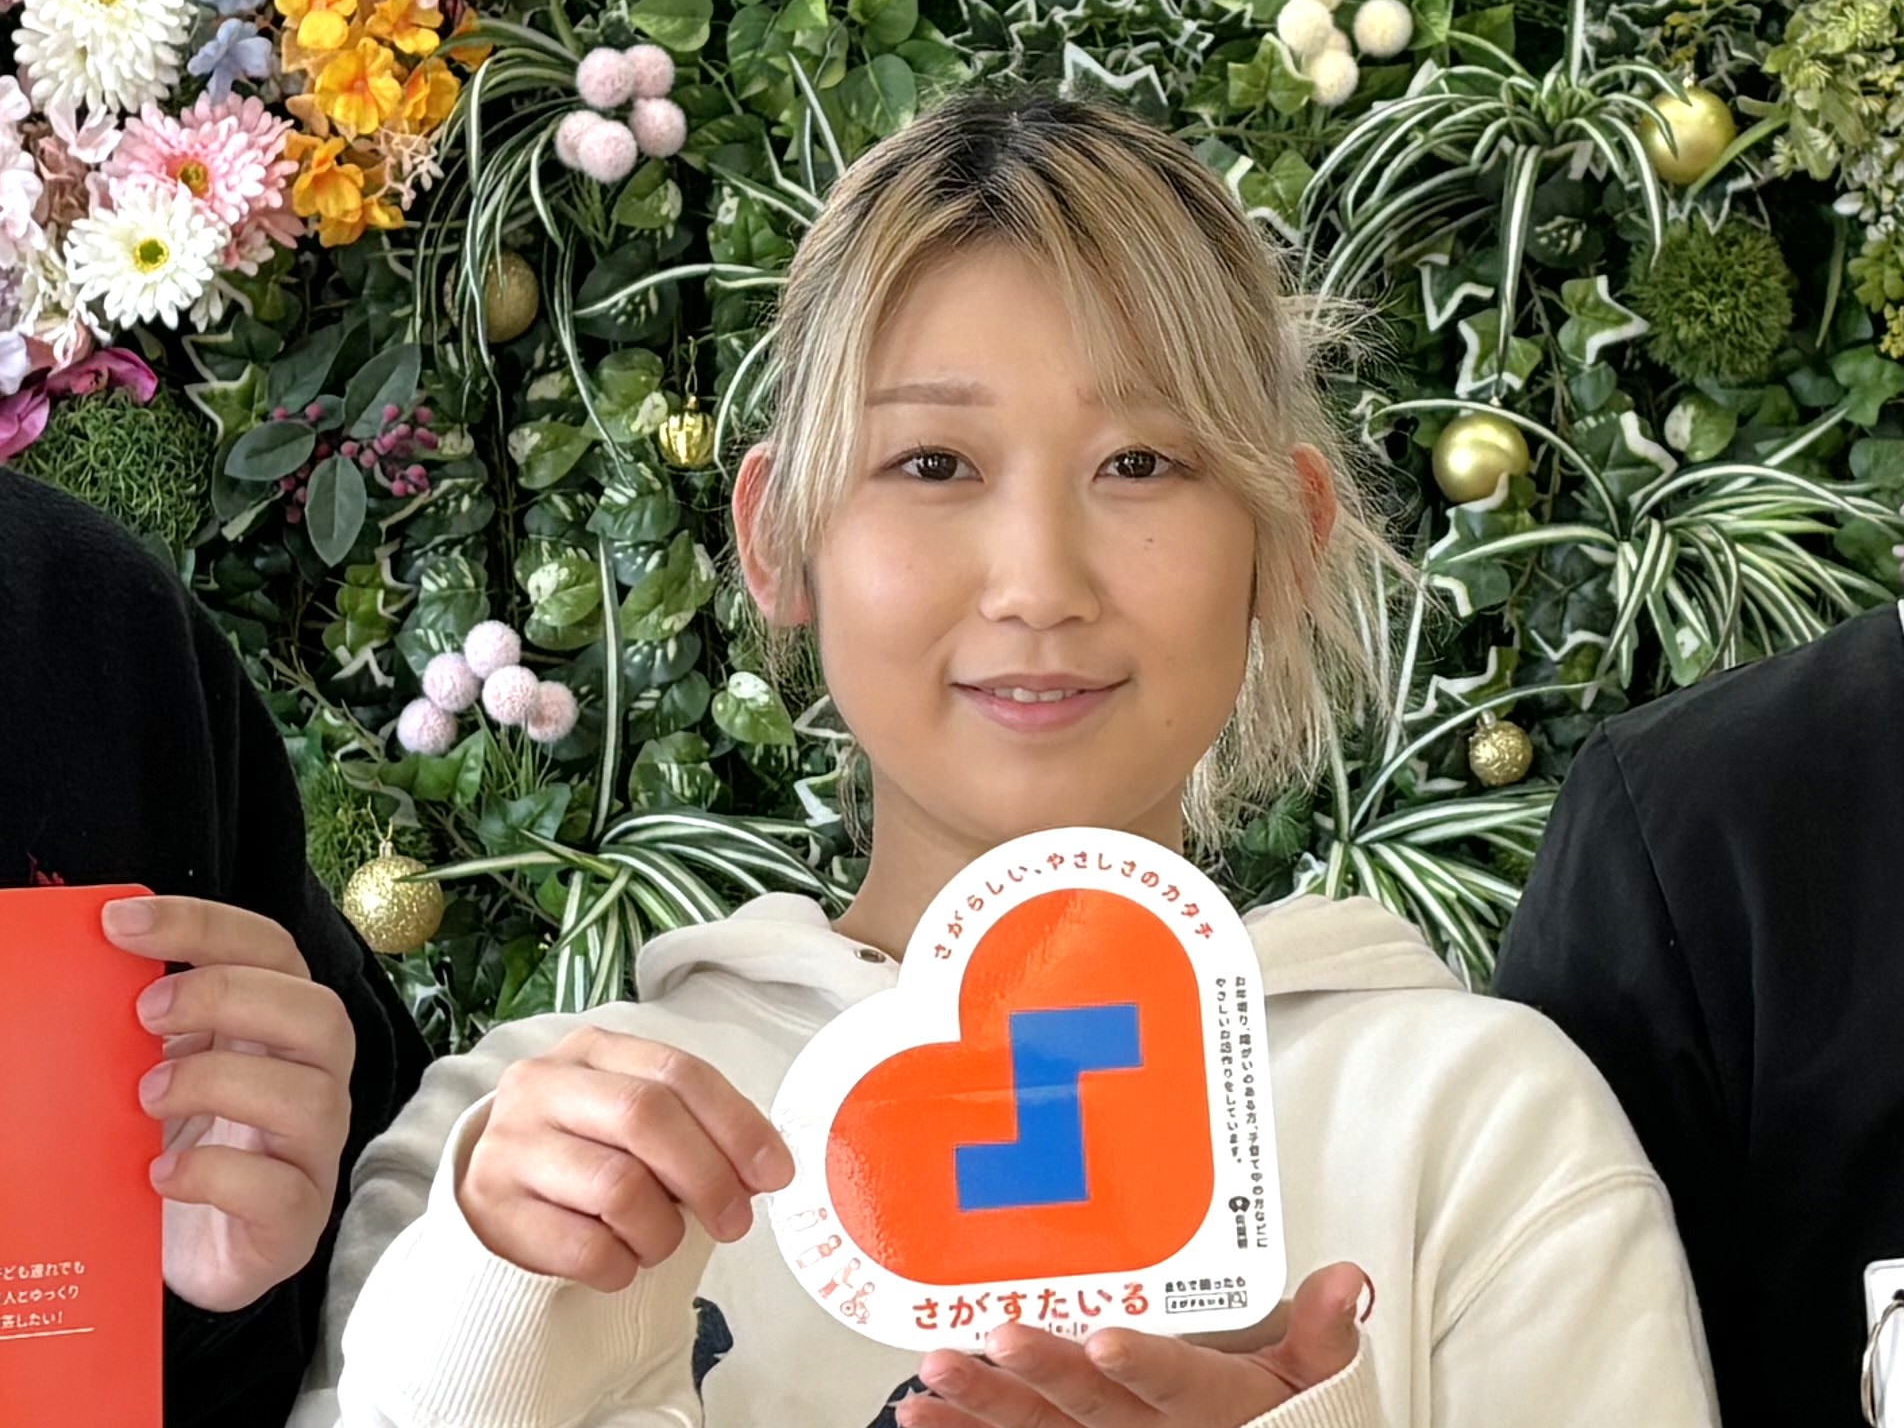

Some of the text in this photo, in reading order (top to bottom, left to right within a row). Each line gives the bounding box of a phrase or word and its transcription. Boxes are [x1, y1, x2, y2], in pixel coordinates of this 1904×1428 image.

[912, 1281, 1149, 1330] さがすたいる
